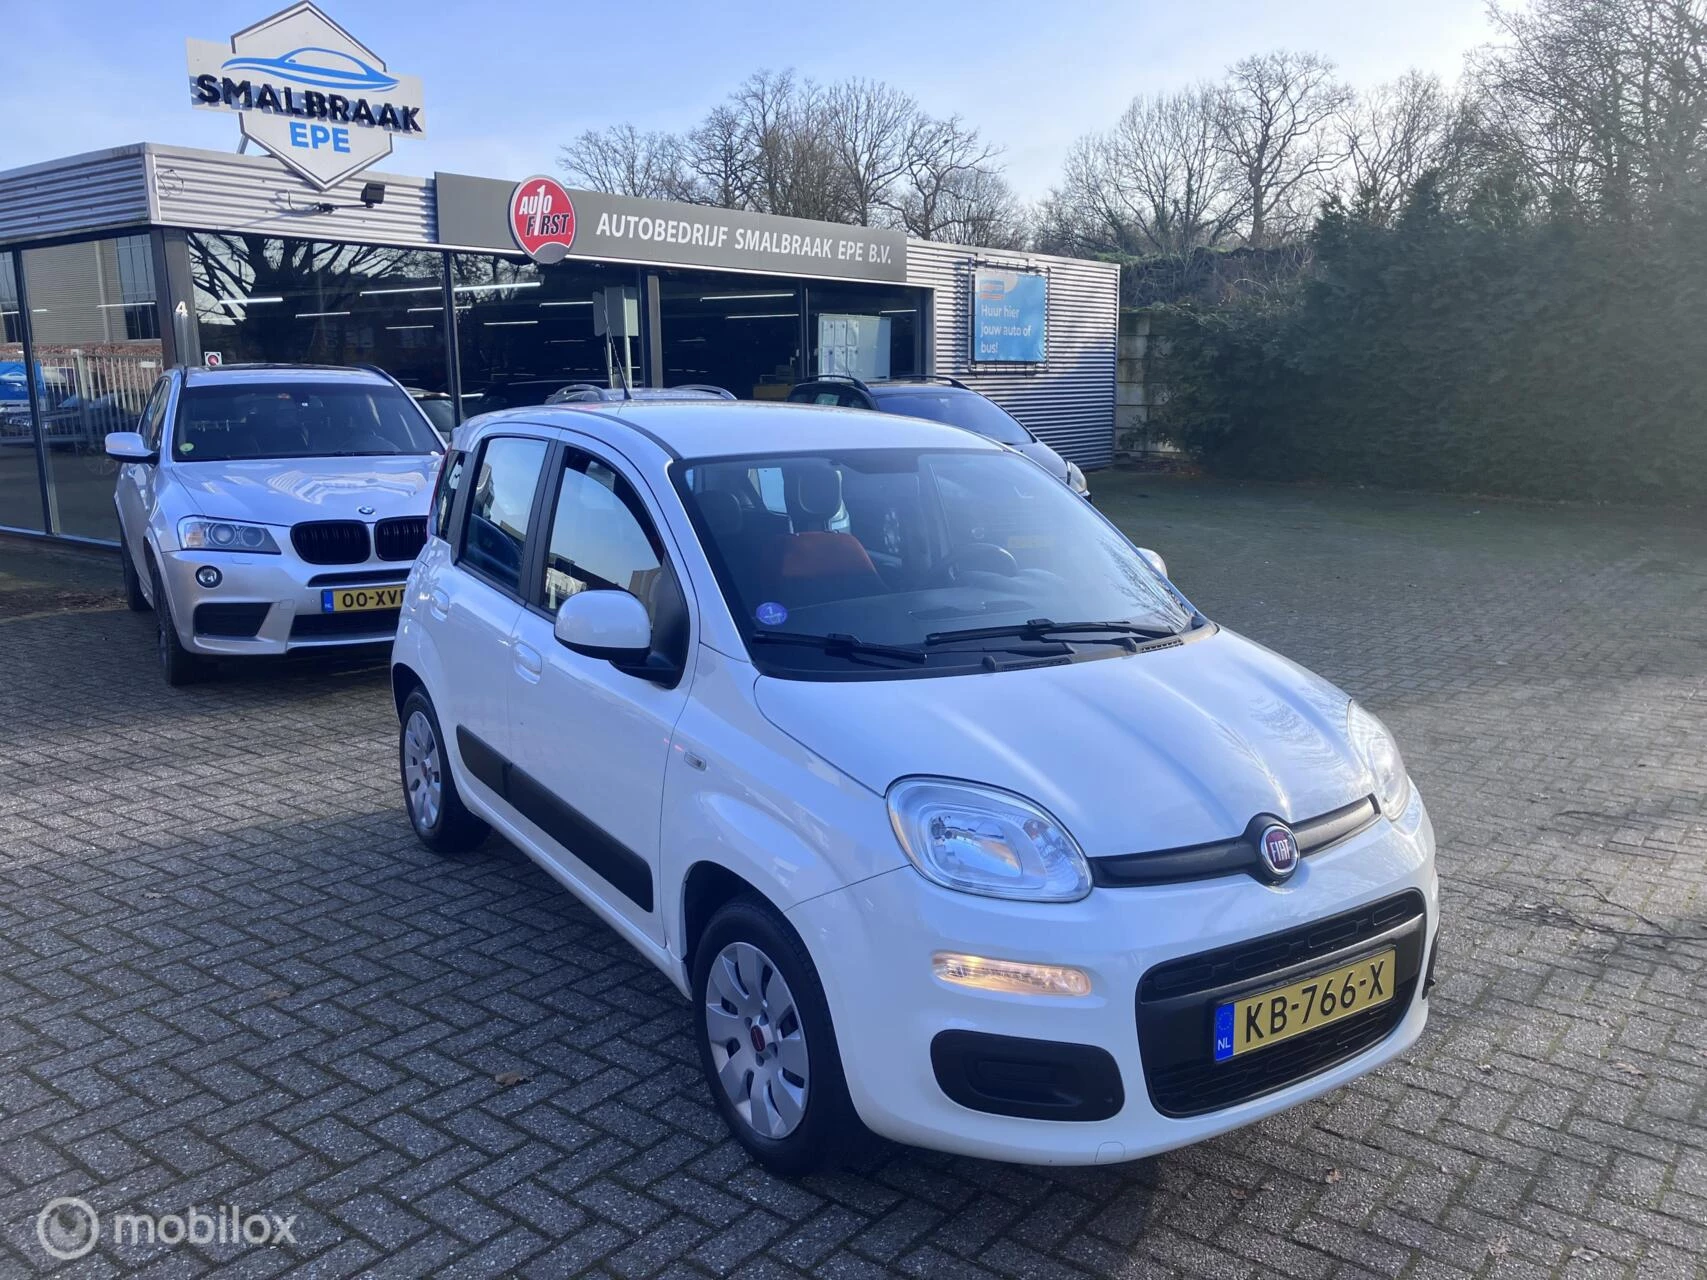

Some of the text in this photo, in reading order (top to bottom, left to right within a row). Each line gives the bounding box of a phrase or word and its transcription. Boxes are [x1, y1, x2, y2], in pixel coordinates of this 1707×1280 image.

[197, 74, 422, 133] SMALBRAAK
[289, 121, 351, 153] EPE
[596, 212, 892, 265] AUTOBEDRIJF SMALBRAAK EPE B.V.
[175, 300, 189, 317] 4
[980, 304, 1020, 319] Huur hier
[980, 322, 1032, 338] jouw auto of
[980, 341, 999, 354] bus!
[1269, 839, 1291, 863] FIAT
[1245, 960, 1385, 1044] KB-766-X
[1217, 1036, 1232, 1052] NL
